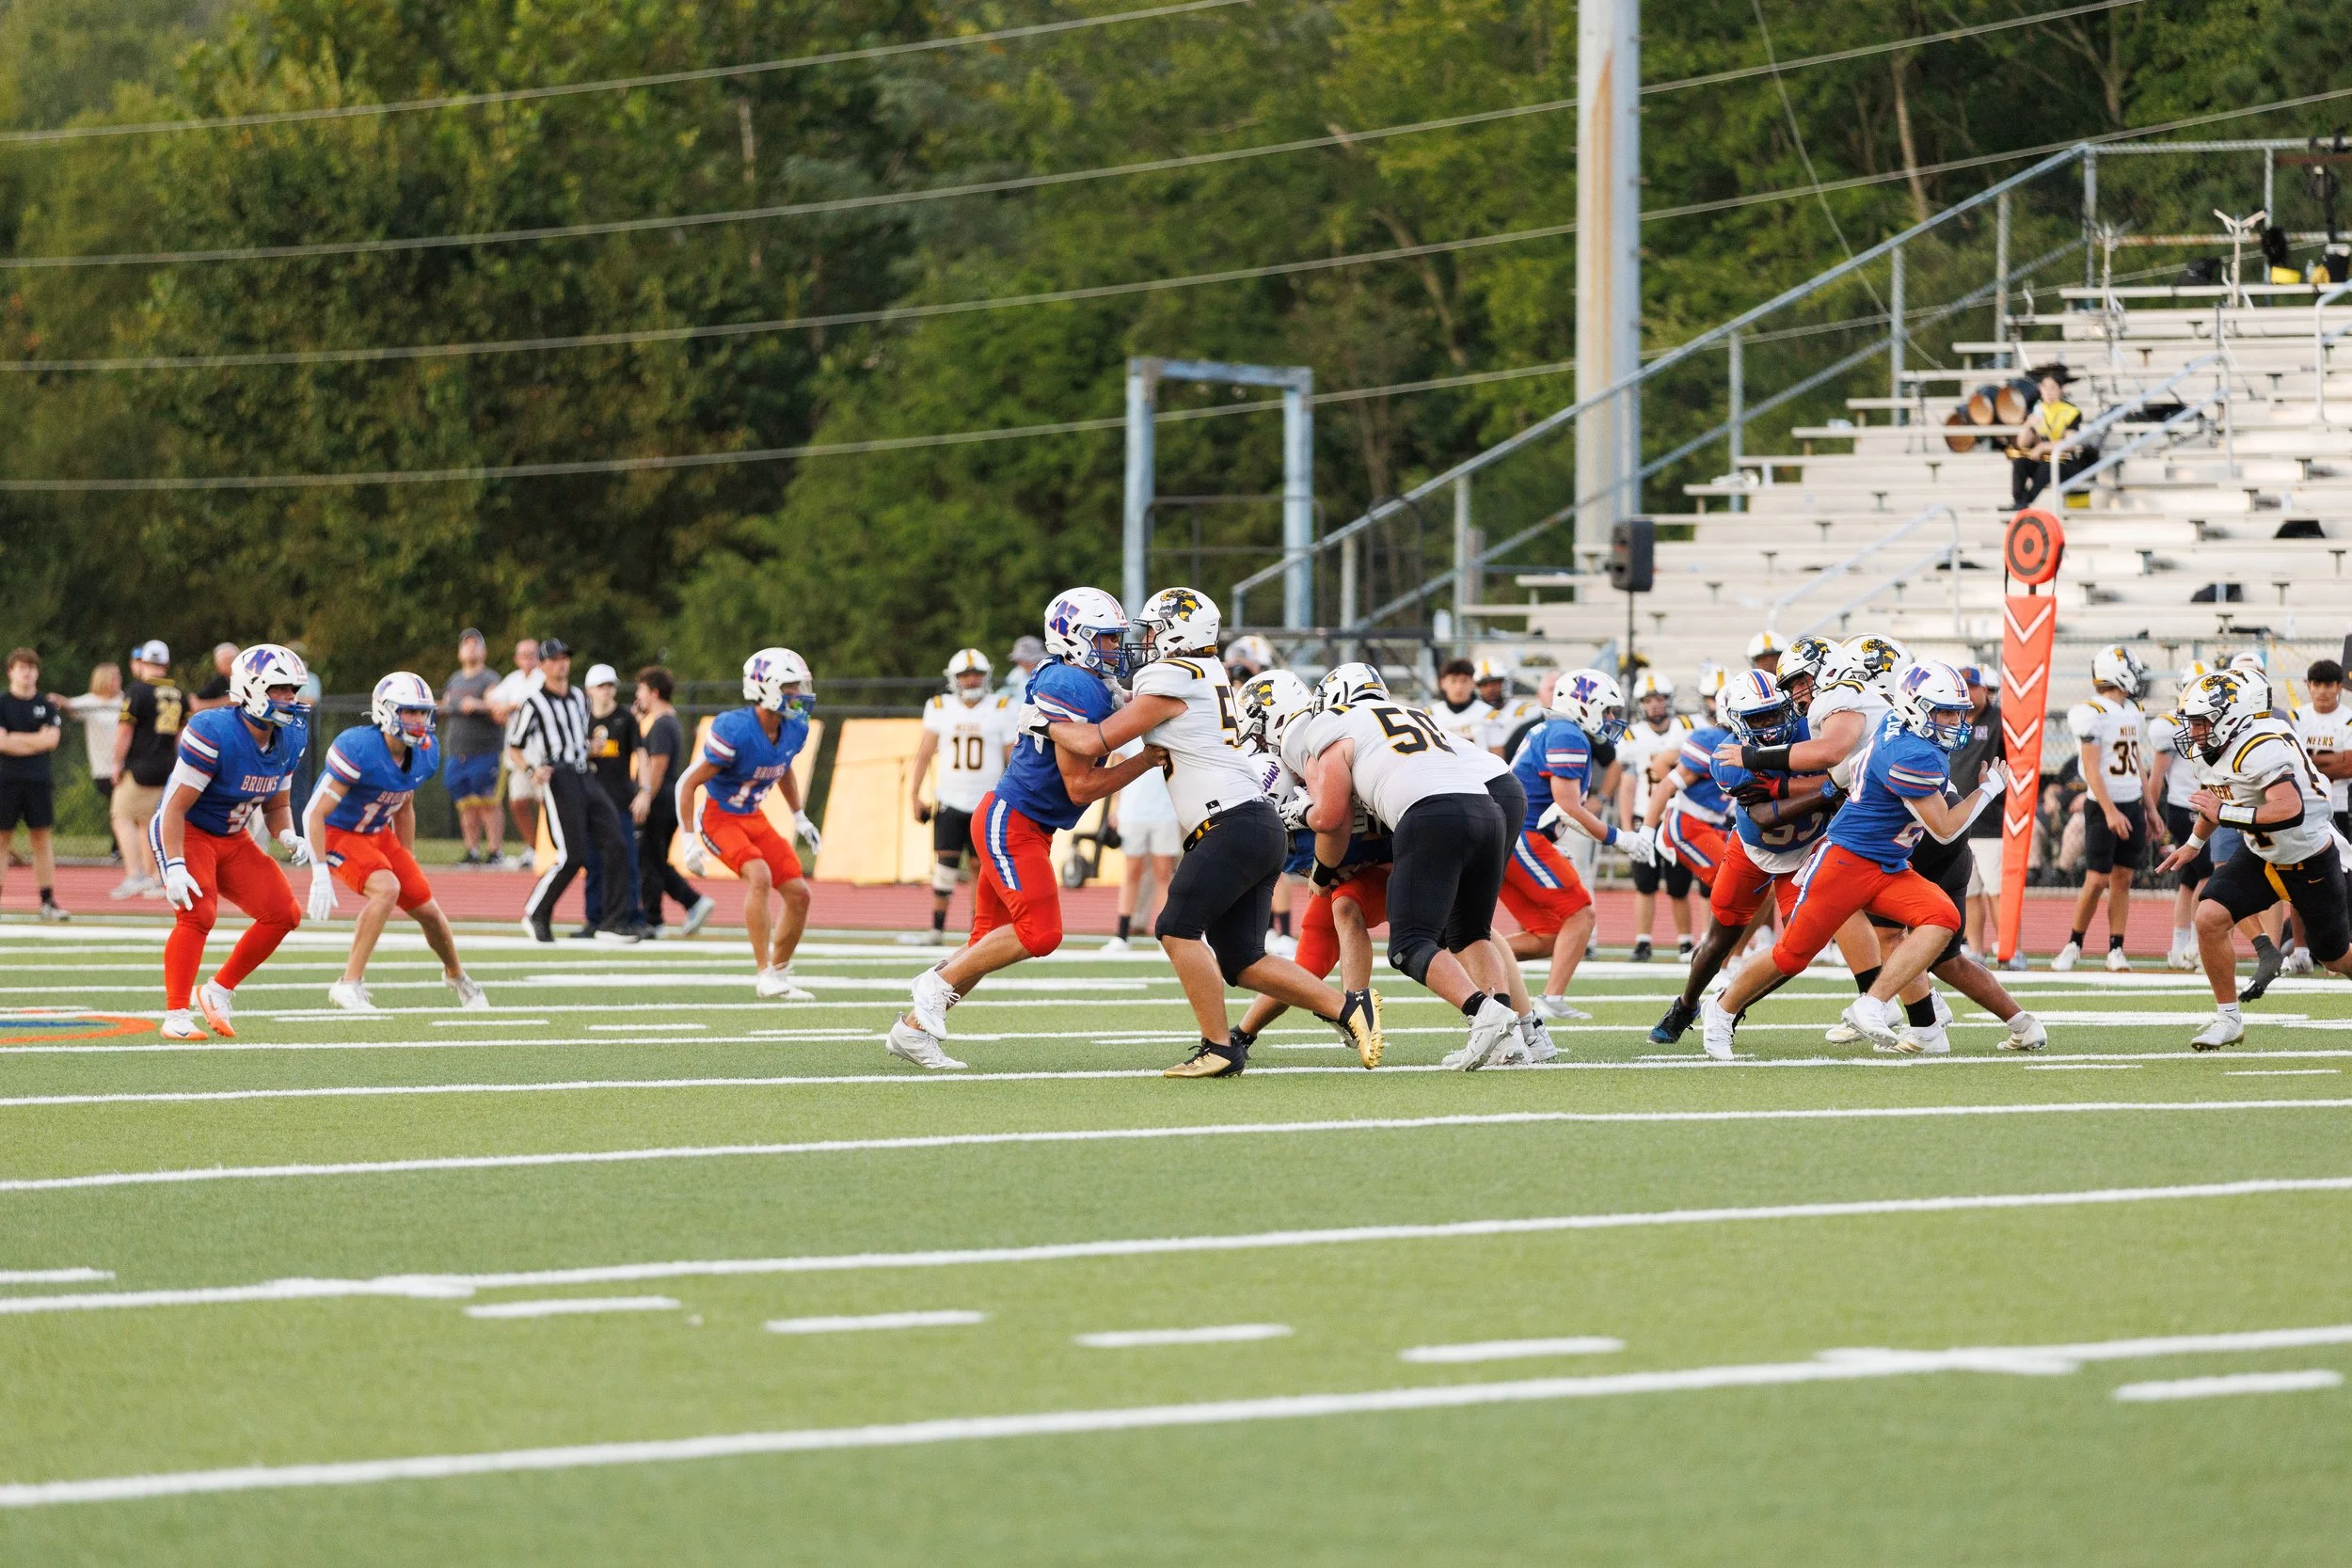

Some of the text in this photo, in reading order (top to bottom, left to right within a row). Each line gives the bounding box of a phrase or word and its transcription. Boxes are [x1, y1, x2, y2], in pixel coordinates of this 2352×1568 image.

[244, 648, 276, 677] N
[1569, 676, 1598, 704] N
[1900, 666, 1931, 697] N
[953, 736, 983, 770] 10
[2306, 736, 2334, 747] NEERS
[240, 775, 280, 793] BRUINS
